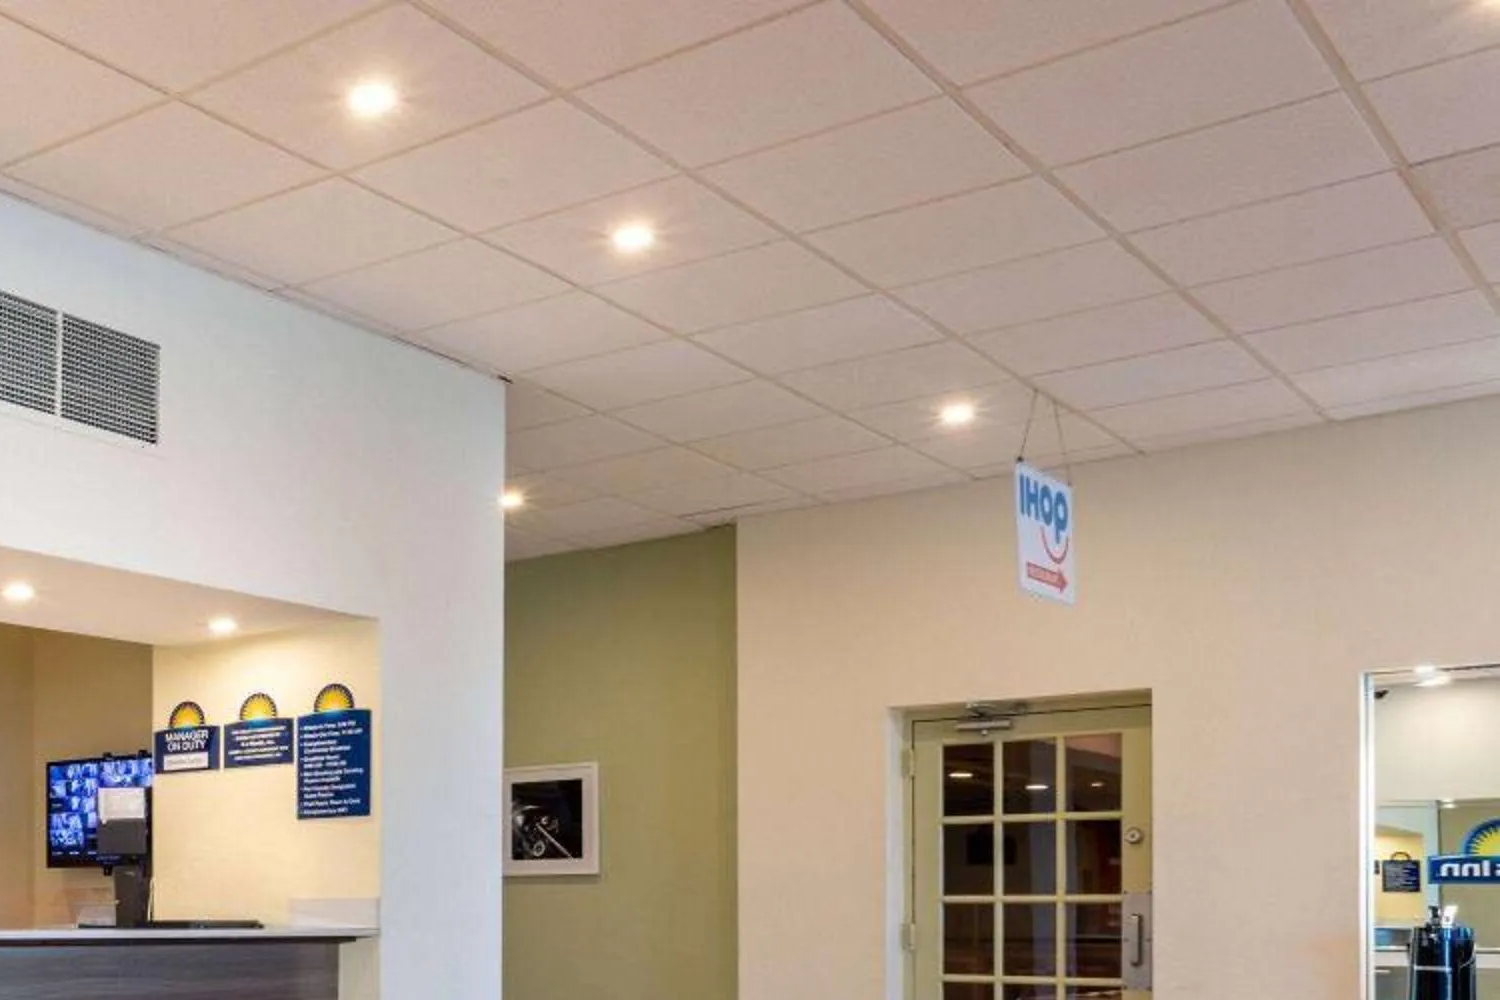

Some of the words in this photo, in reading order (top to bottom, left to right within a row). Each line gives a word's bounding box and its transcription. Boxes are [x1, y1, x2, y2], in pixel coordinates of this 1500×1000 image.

[165, 729, 209, 742] MANAGER
[167, 741, 181, 752] ON
[182, 739, 207, 751] DUTY
